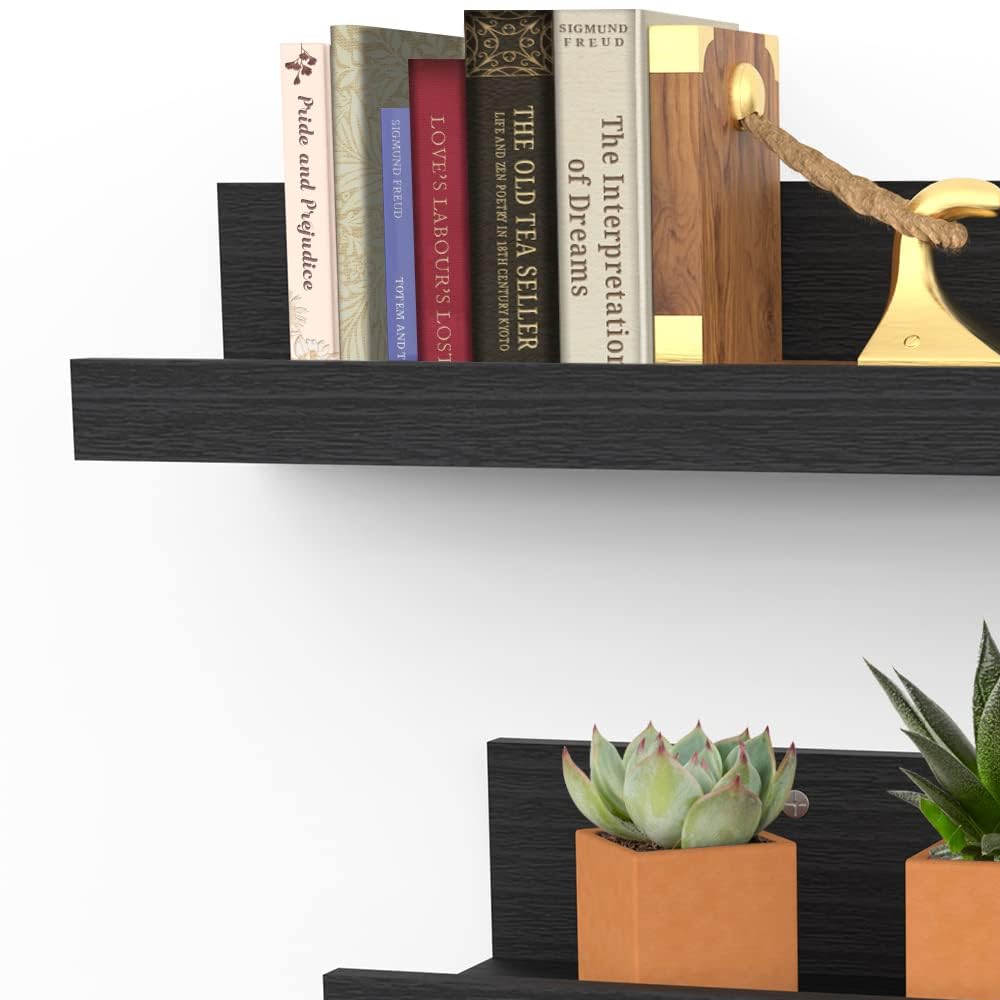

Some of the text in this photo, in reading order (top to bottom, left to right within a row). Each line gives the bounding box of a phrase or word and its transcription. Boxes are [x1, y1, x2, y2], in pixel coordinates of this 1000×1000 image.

[559, 23, 628, 34] SIGMUND
[563, 37, 625, 48] FREUD
[391, 119, 403, 219] SIGMUND FREUD
[601, 115, 624, 164] The
[296, 95, 318, 291] Pride and Prejudice
[430, 115, 452, 362] LOVE'S LABOUR'S LOST
[494, 112, 510, 352] LIFE AND ZEN POETRY IN 18TH CENTURY KYOTO
[513, 105, 539, 351] THE OLD TEA SELLER
[568, 159, 592, 297] of Dreams
[395, 277, 405, 320] TOTEM
[396, 324, 406, 353] AND
